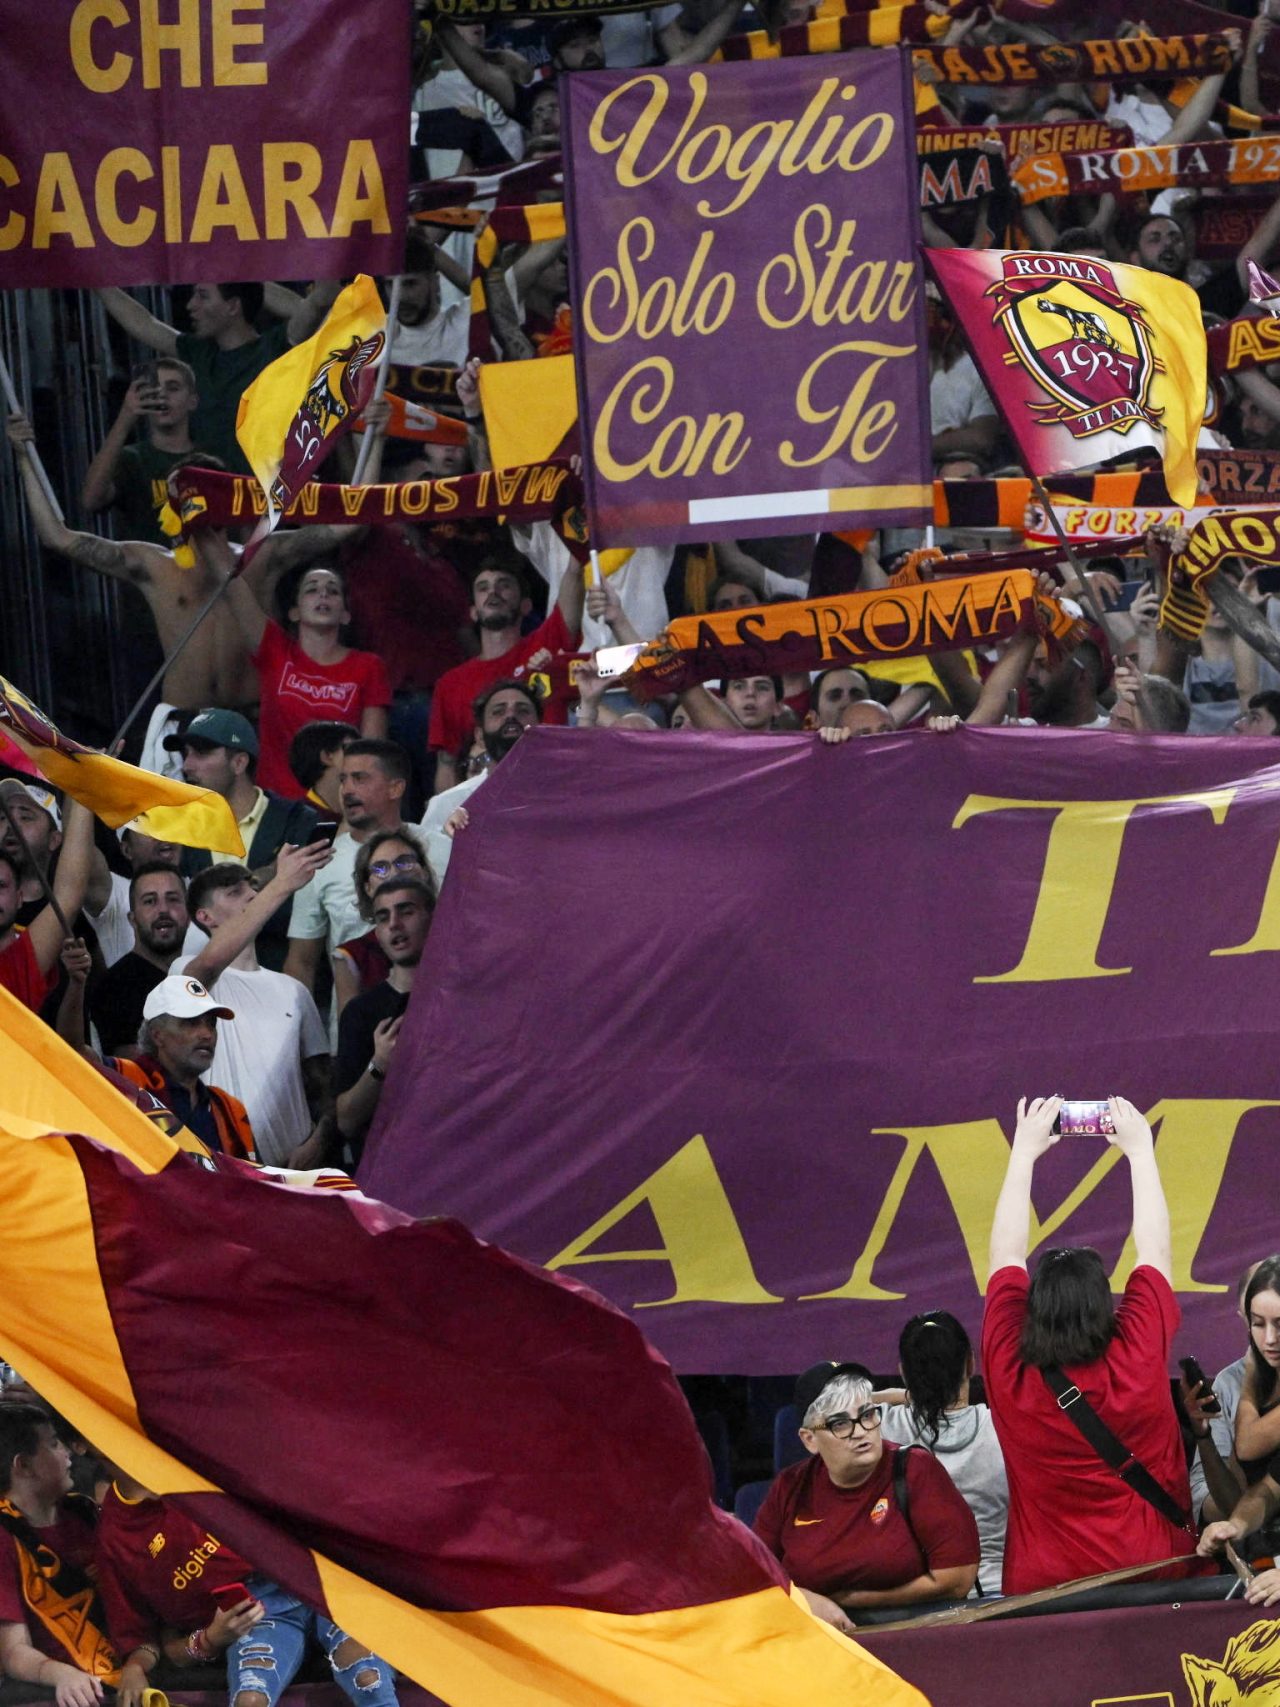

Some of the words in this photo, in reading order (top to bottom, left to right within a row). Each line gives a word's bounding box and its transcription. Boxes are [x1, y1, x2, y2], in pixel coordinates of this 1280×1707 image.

[69, 0, 268, 94] CHE
[588, 71, 894, 217] Voglio
[1010, 124, 1111, 156] INSIEME
[1080, 148, 1210, 182] ROMA
[583, 216, 736, 343] Solo
[757, 203, 917, 330] Star
[1012, 258, 1103, 286] ROMA
[1053, 344, 1134, 389] 1927
[593, 355, 750, 482] Con
[779, 340, 917, 467] Te
[1078, 410, 1104, 431] TI
[1110, 401, 1149, 421] AM
[1064, 509, 1184, 535] FORZA
[807, 575, 1022, 661] ROMA
[173, 1533, 220, 1590] digital
